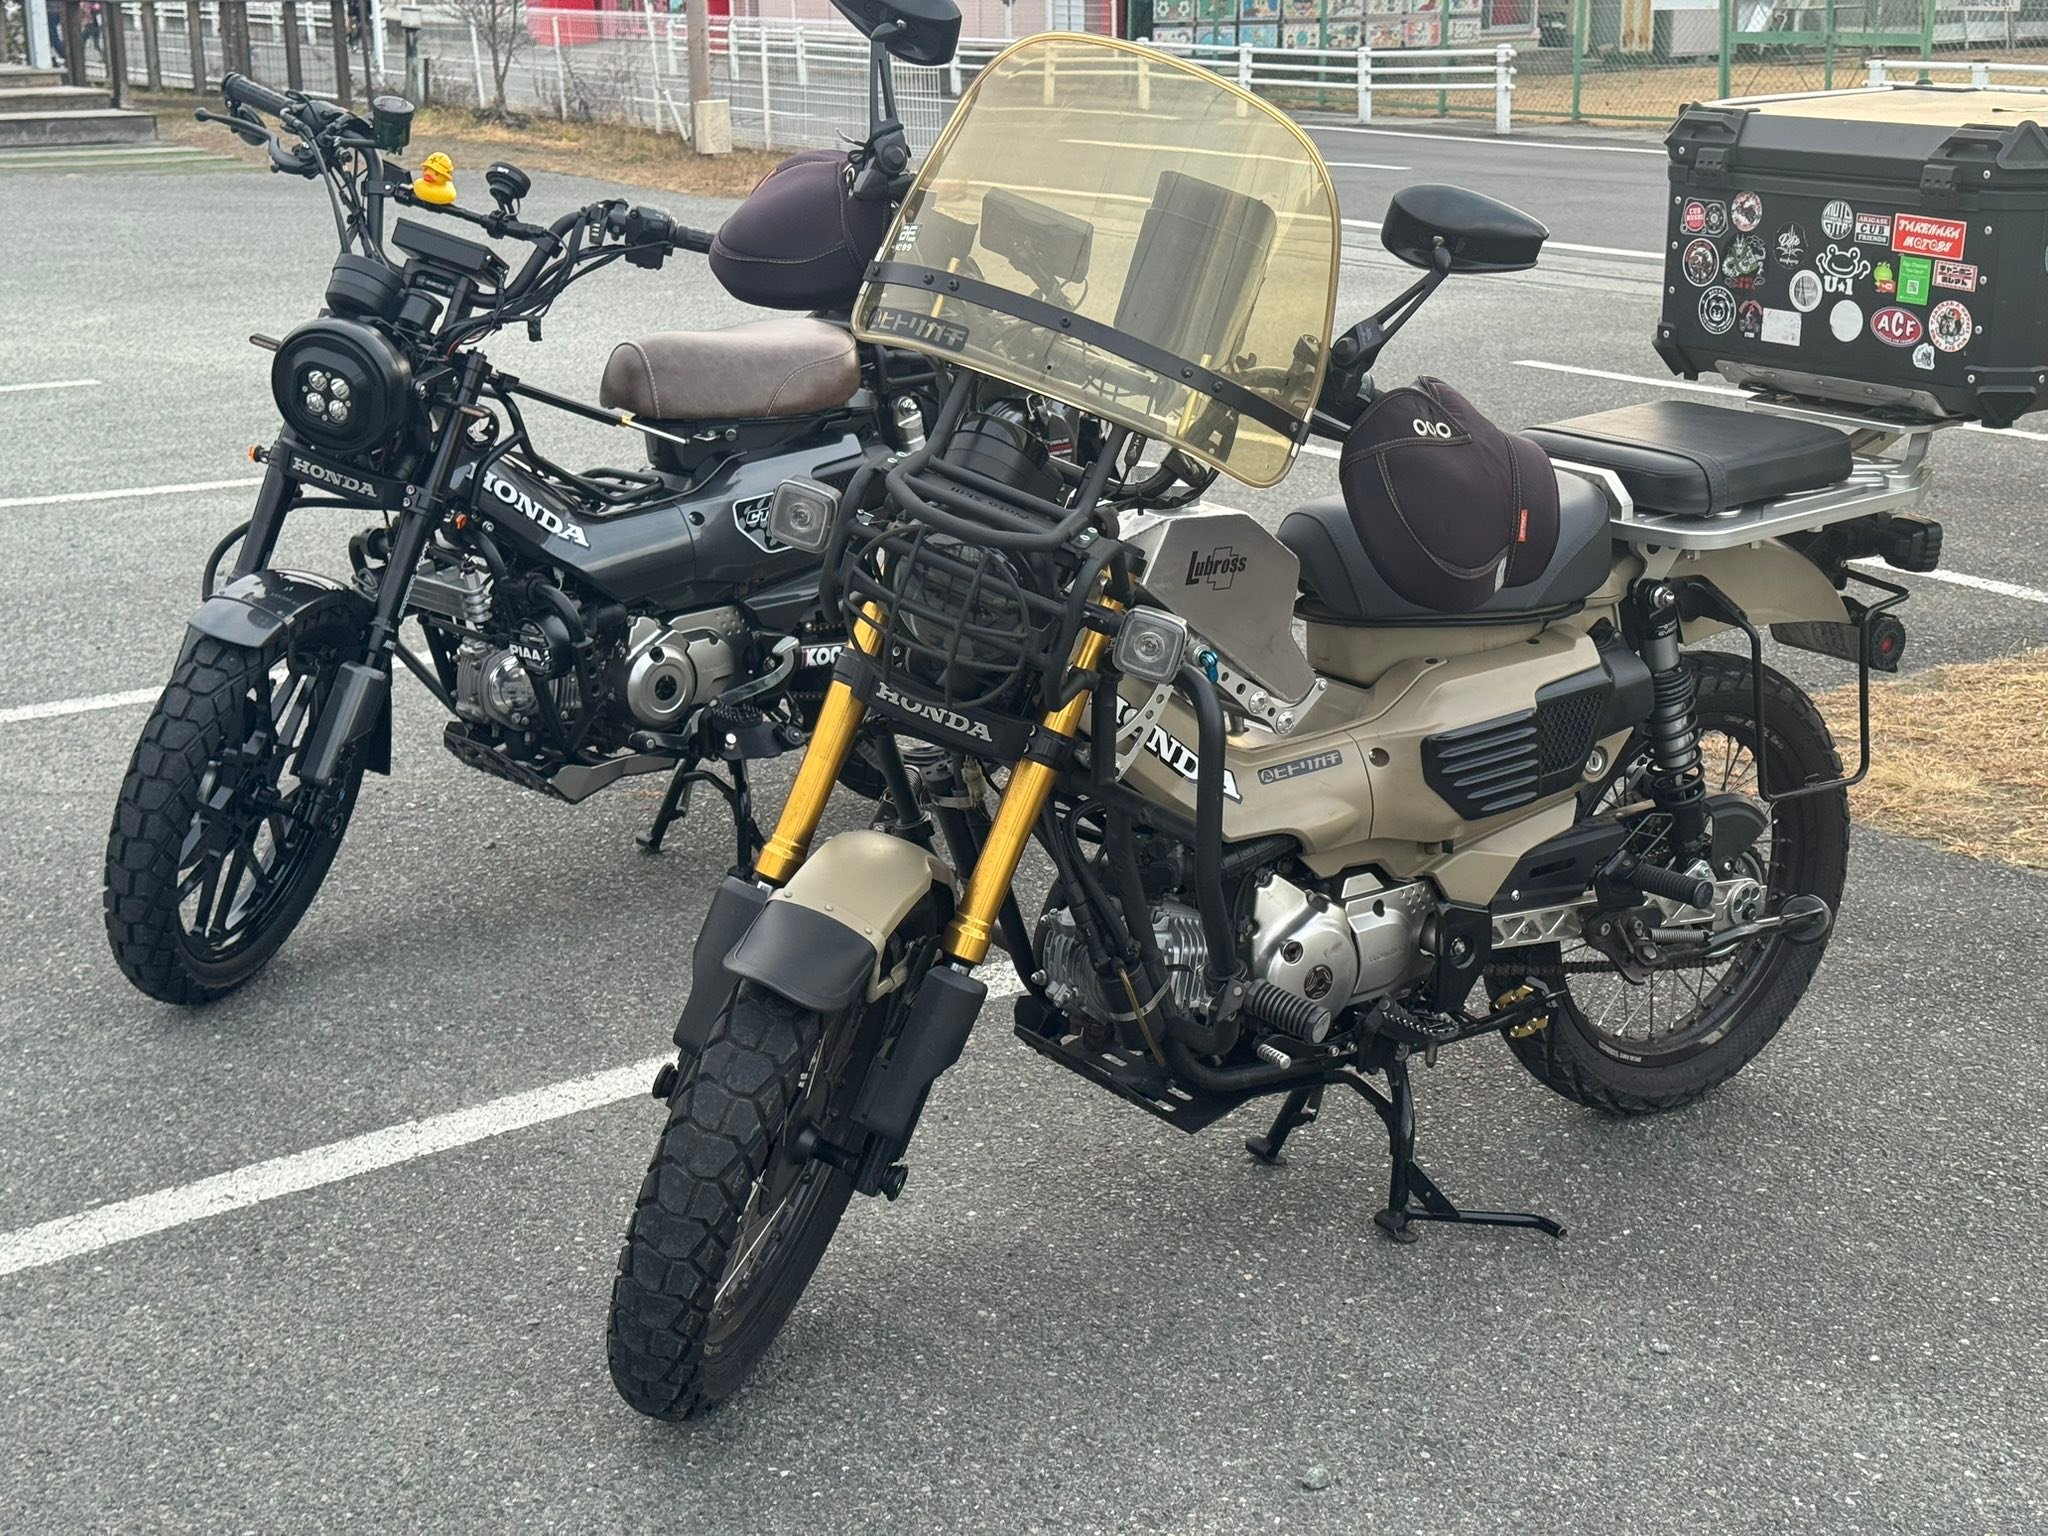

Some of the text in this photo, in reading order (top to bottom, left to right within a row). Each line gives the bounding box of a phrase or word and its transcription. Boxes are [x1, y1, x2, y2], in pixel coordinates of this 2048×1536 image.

[1857, 234, 1887, 243] FRIENDS
[1860, 223, 1885, 235] CUB
[1898, 219, 1962, 240] TAKENAKA
[1903, 236, 1953, 253] MOTORS
[1876, 311, 1917, 338] ACF
[292, 456, 377, 498] HONDA
[465, 461, 590, 548] HONDA
[1185, 550, 1248, 586] Lubross
[509, 644, 542, 662] PIAA
[876, 681, 993, 743] HONDA
[1116, 694, 1242, 802] NDA
